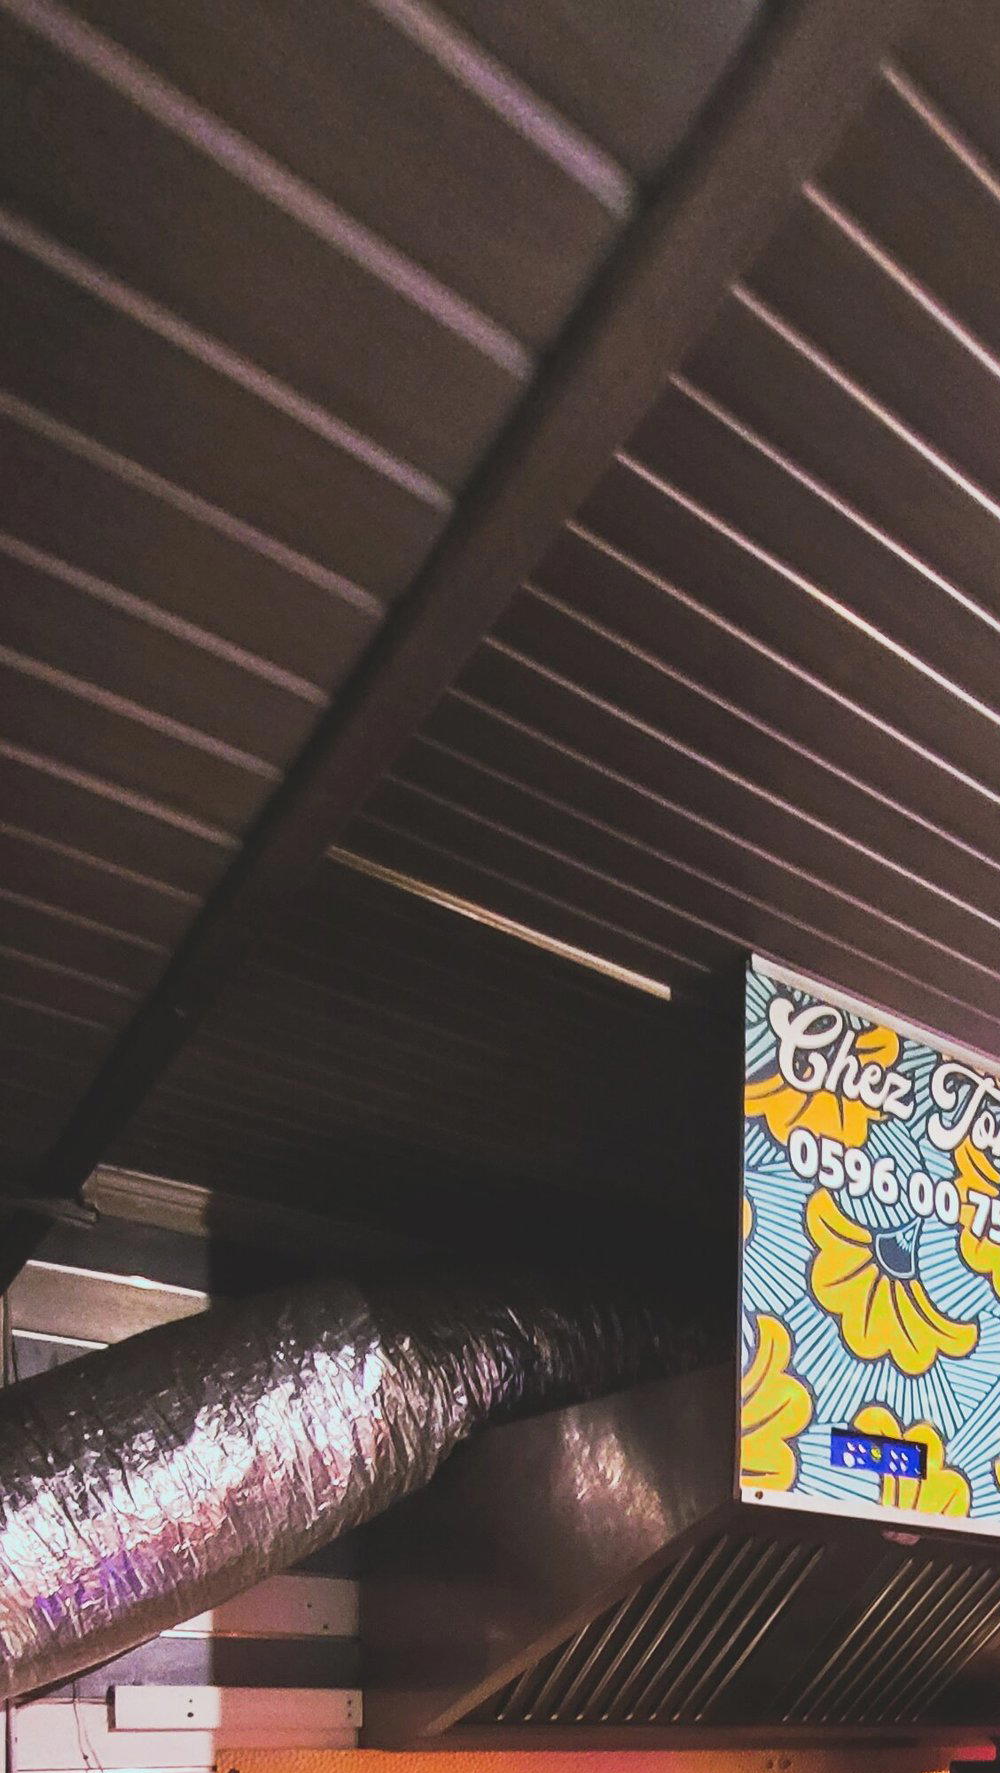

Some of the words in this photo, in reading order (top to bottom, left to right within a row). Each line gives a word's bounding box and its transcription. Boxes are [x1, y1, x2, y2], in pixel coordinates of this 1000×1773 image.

[770, 998, 914, 1119] Chez
[789, 1129, 899, 1204] 0596
[910, 1172, 959, 1223] 00
